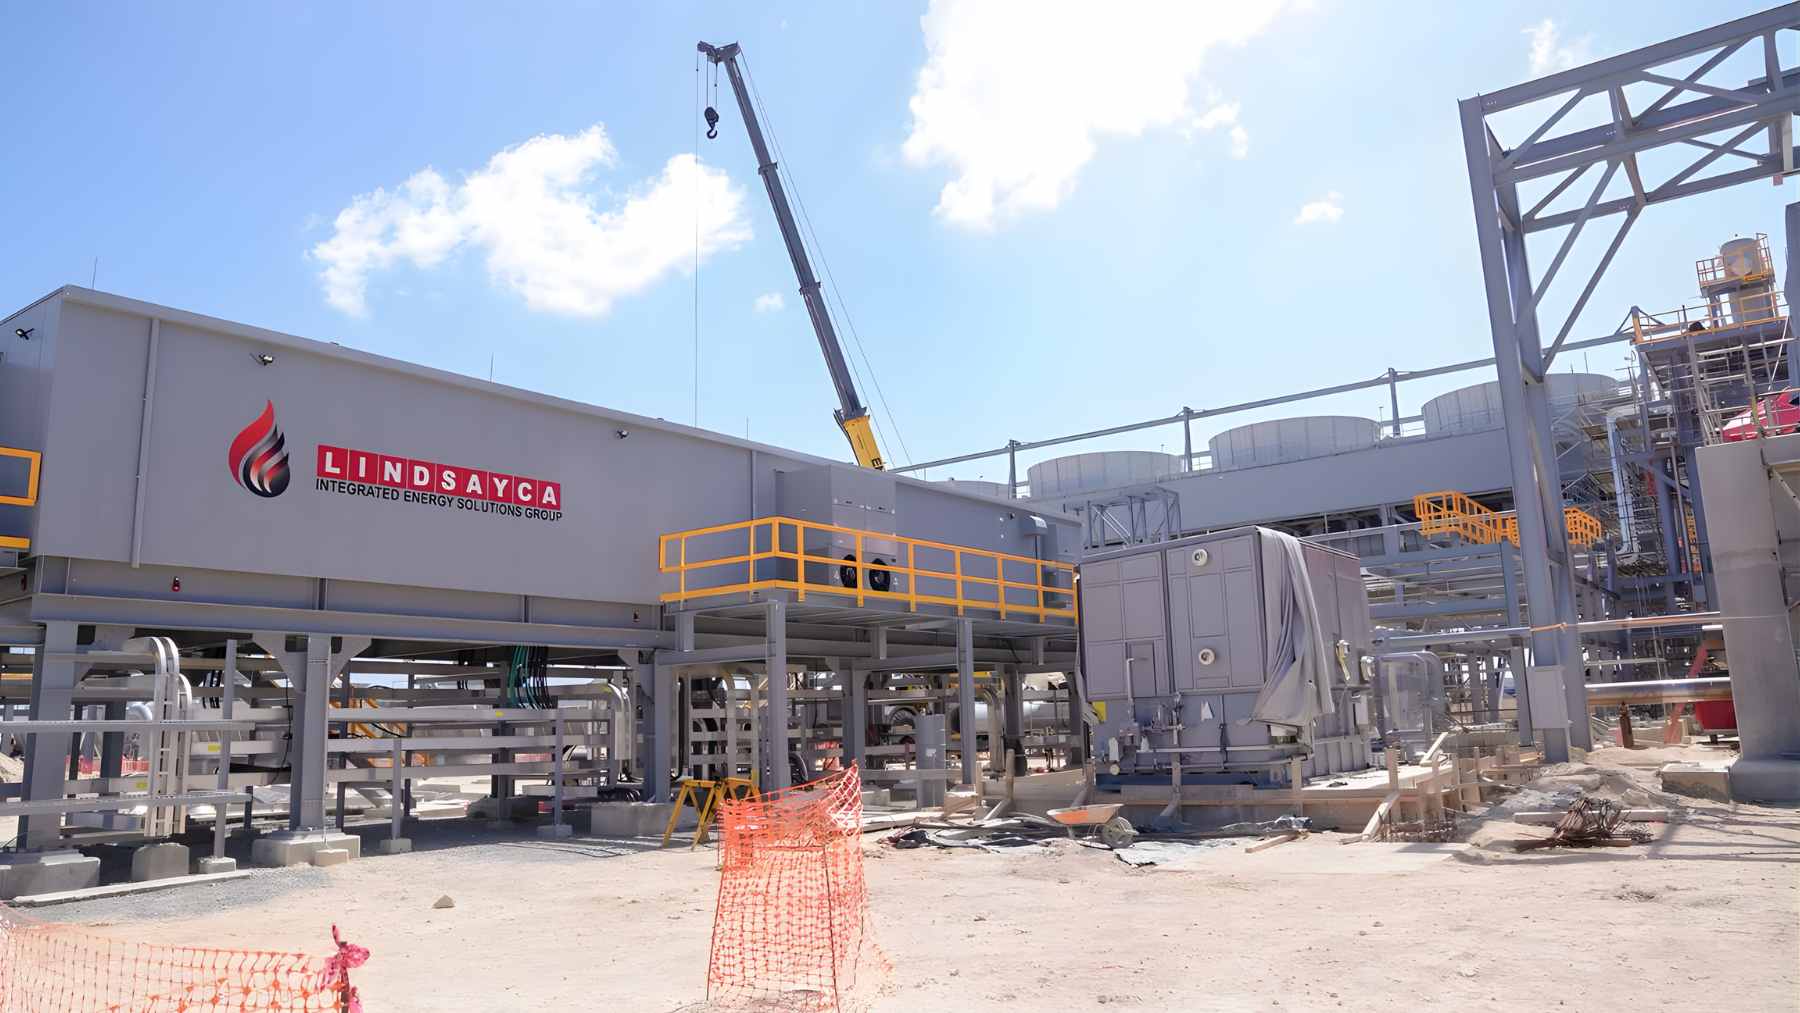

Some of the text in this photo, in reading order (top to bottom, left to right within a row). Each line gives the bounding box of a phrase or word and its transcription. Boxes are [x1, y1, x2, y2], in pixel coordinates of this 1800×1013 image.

[315, 478, 563, 521] INTEGRATED ENERGY SOLUTIONS GROUP
[325, 451, 557, 505] LINDSAYCA
